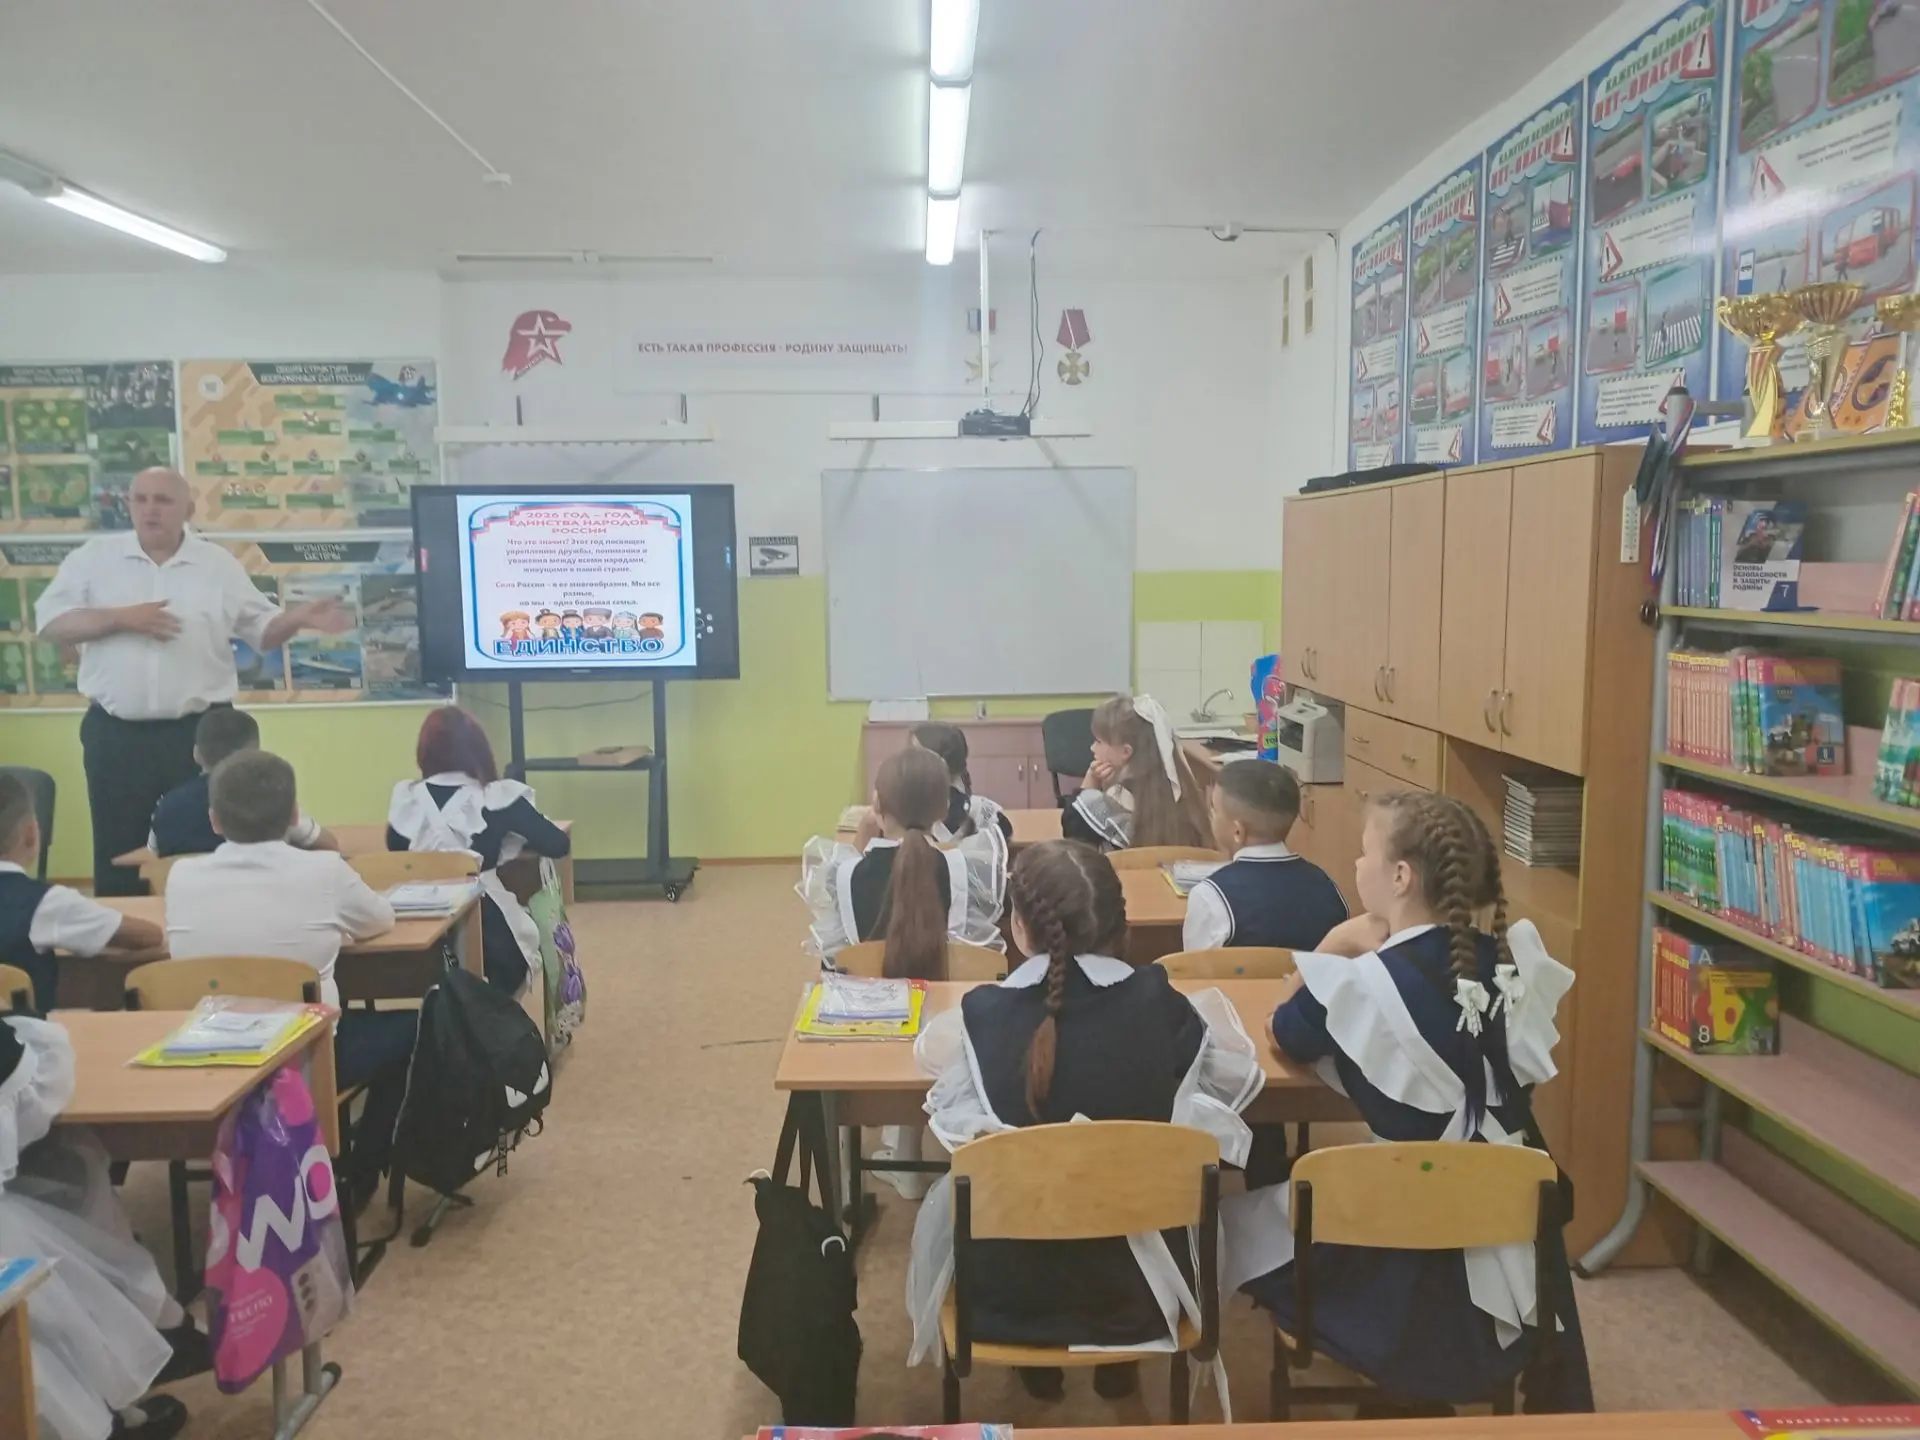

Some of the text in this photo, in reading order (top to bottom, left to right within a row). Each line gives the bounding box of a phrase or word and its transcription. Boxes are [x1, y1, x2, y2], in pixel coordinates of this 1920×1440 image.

[638, 343, 664, 354] ЕСТЬ
[666, 343, 704, 354] ТАКАЯ
[706, 343, 777, 354] ПРОФЕССИЯ
[785, 343, 833, 355] РОДИНУ
[836, 343, 908, 355] ЗАЩИЩАТЬ!
[563, 511, 590, 519] ГОД
[604, 511, 631, 519] ГОД
[509, 519, 649, 527] ЕДИНСТВА НАРОДОВ
[1780, 584, 1790, 598] 7
[493, 638, 664, 657] ЕДИНСТВО
[1698, 1024, 1710, 1044] 8
